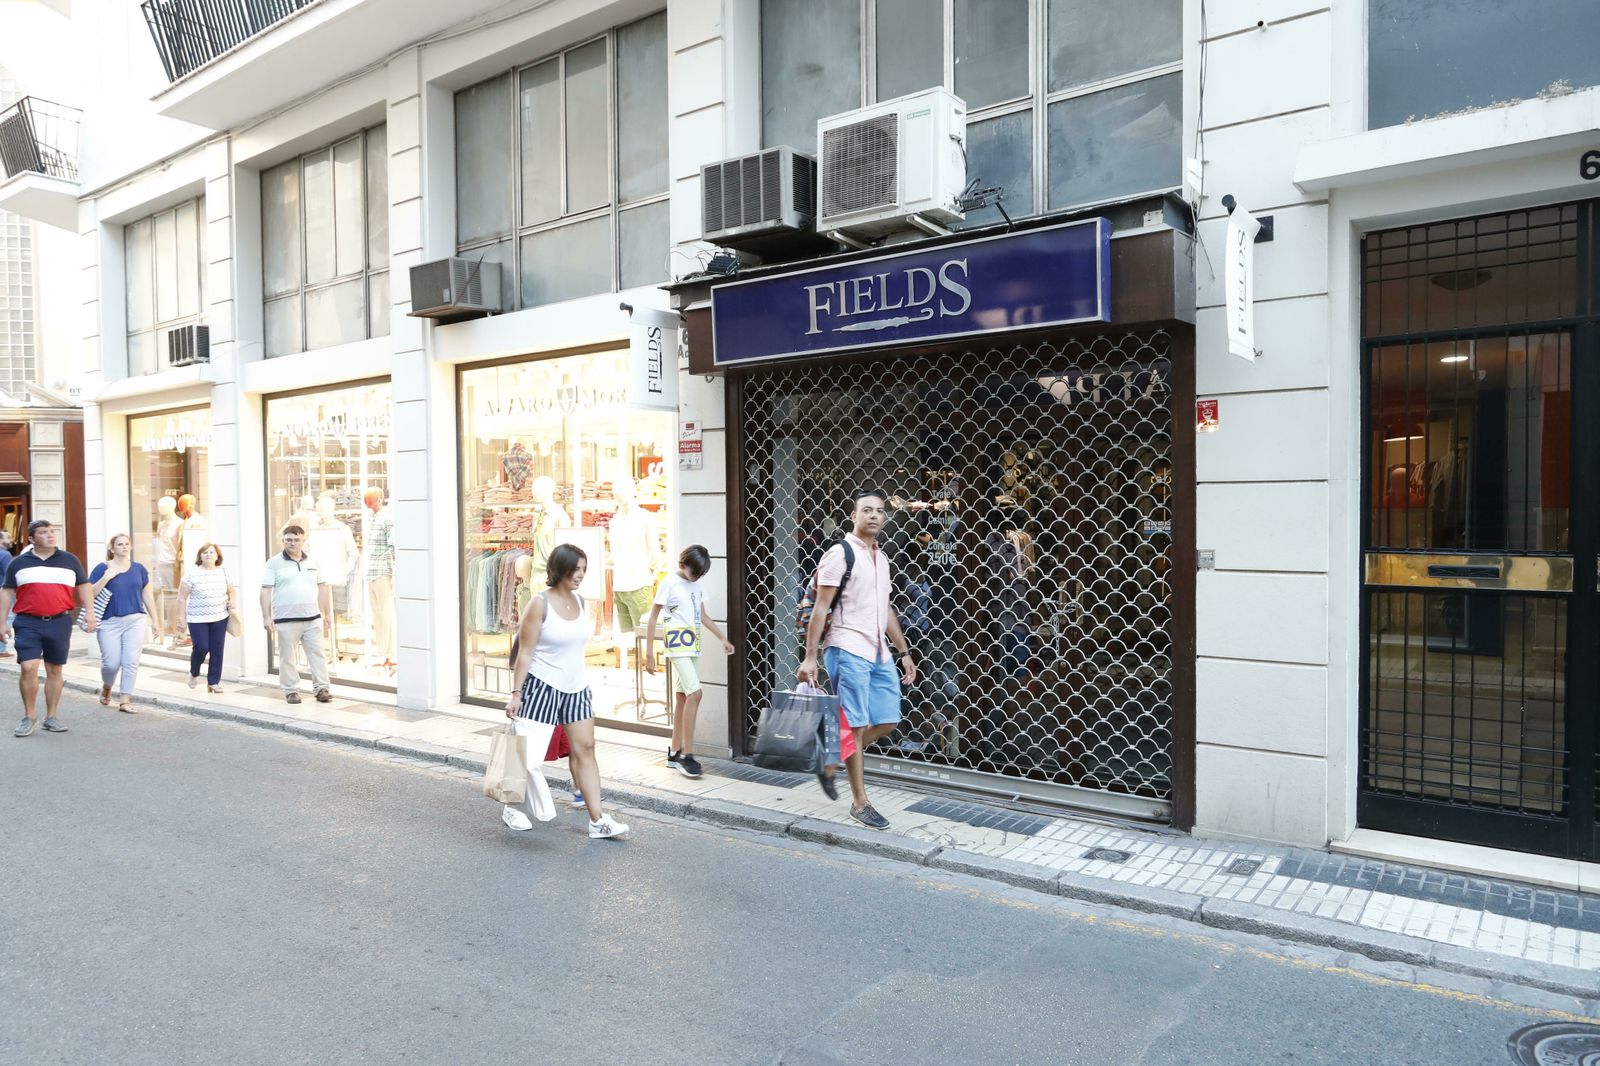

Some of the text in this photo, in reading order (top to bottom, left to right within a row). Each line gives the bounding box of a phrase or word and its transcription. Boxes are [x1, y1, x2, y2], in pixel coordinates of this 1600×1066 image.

[1580, 150, 1600, 180] 6
[803, 258, 972, 335] FIELDS
[647, 326, 662, 394] FIELDS
